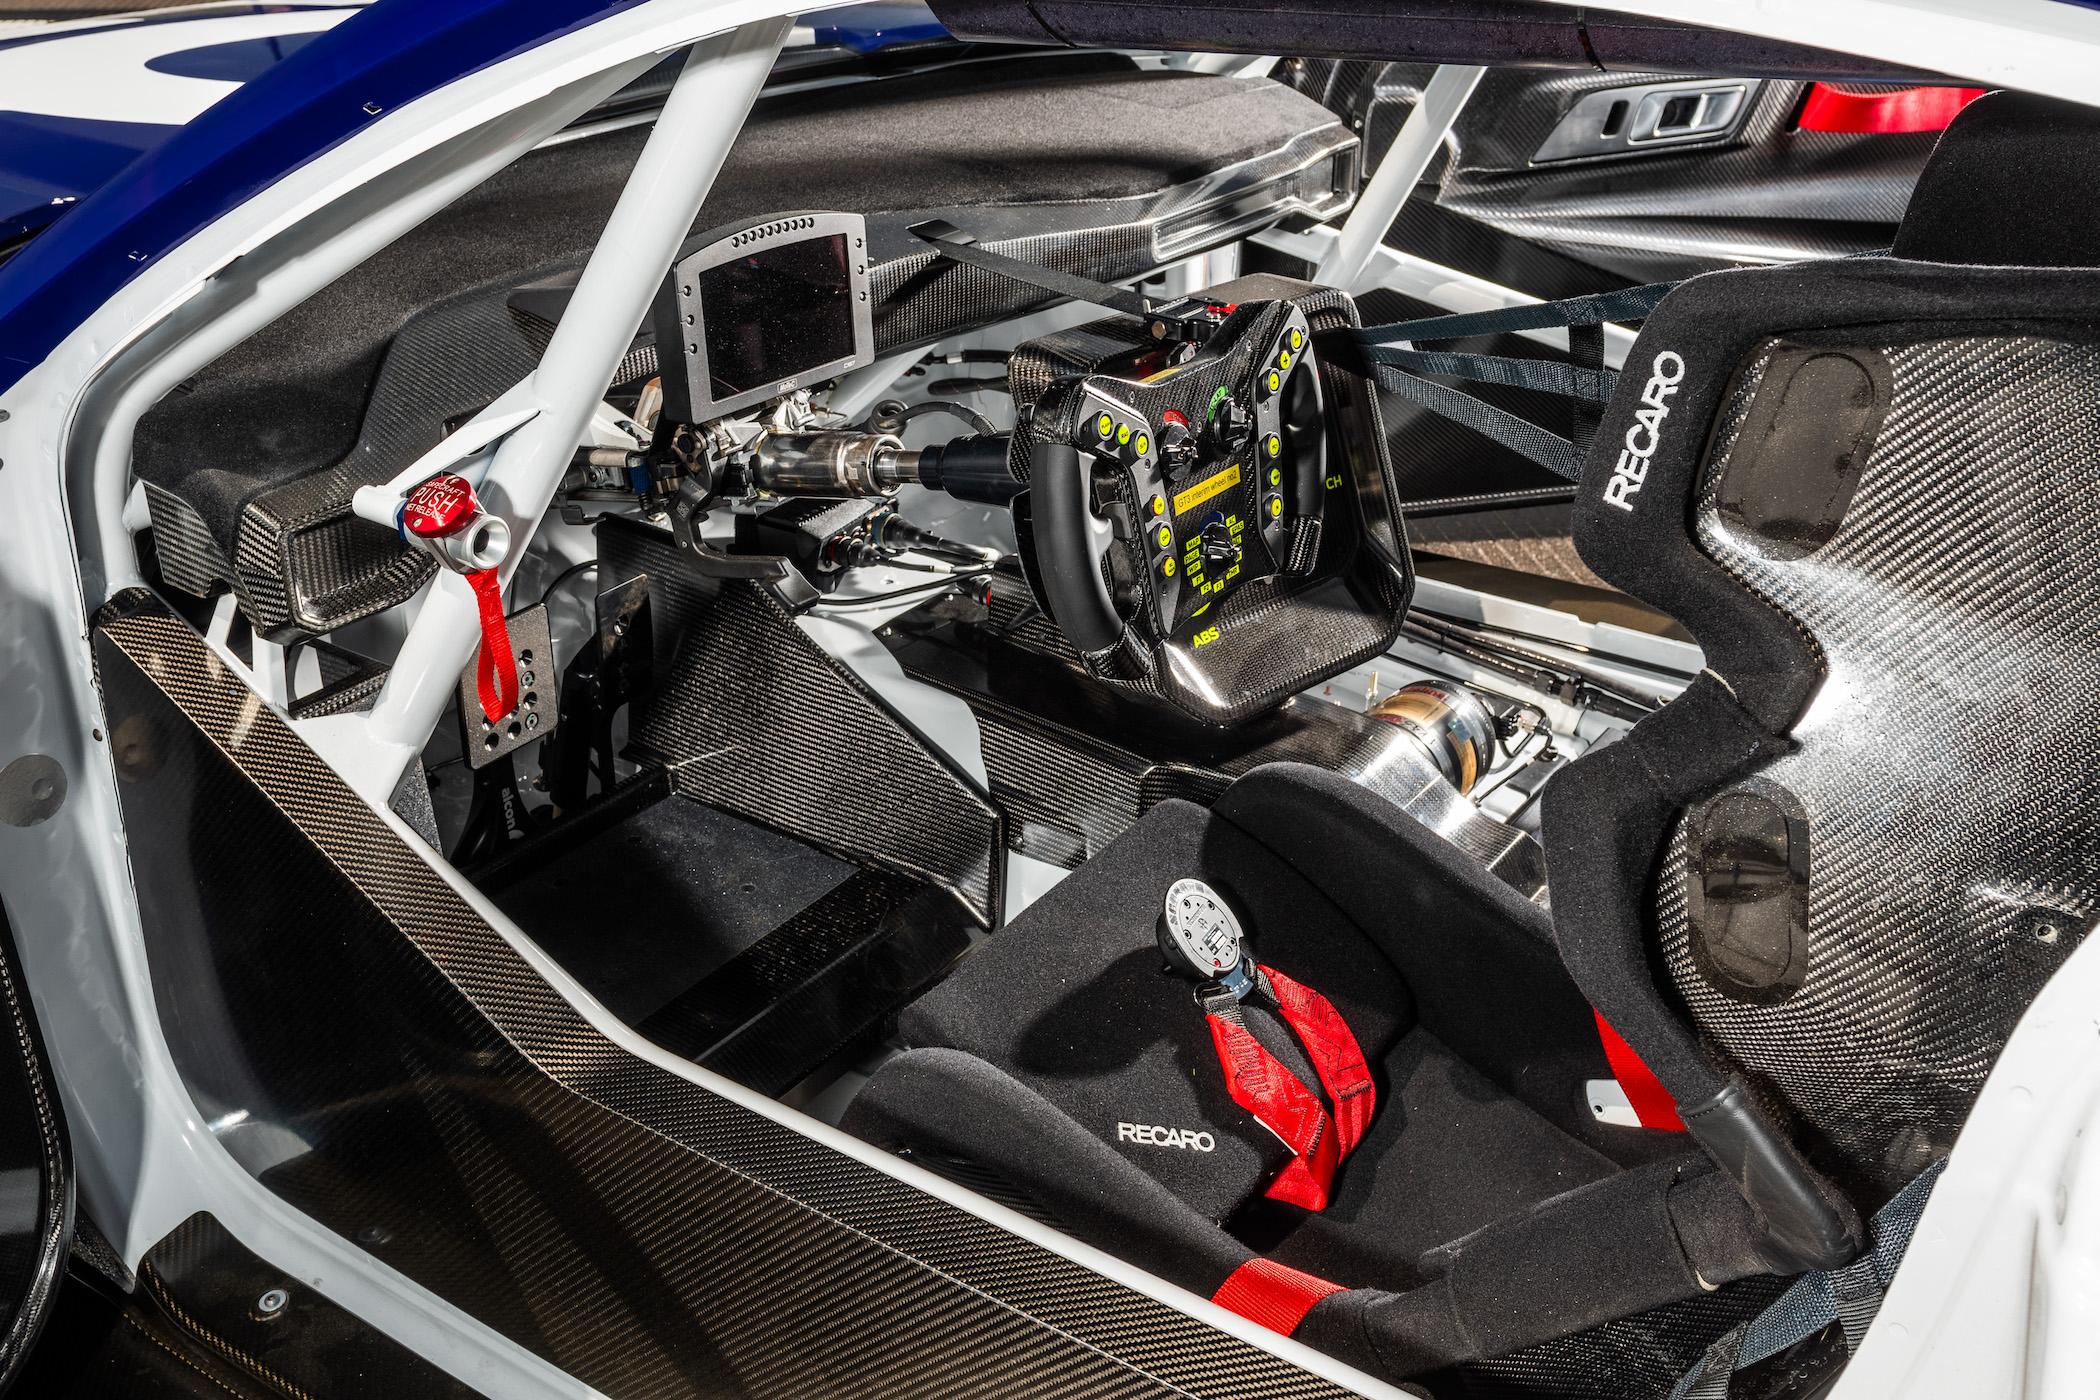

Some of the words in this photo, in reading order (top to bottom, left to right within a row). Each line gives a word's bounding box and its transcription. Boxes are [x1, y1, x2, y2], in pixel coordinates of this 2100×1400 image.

[1603, 350, 1686, 512] RECARO
[425, 481, 466, 497] SAFECRAFT
[1325, 474, 1343, 489] CH
[410, 487, 459, 514] PUSH
[1178, 494, 1191, 508] GT3
[1191, 486, 1211, 501] interim
[1211, 478, 1227, 491] wheel
[415, 504, 446, 520] RELEASE
[1187, 536, 1200, 548] MAP
[1185, 550, 1199, 564] PAGE
[1193, 626, 1220, 648] ABS
[502, 787, 516, 830] alcon
[1117, 1121, 1216, 1152] RECARO
